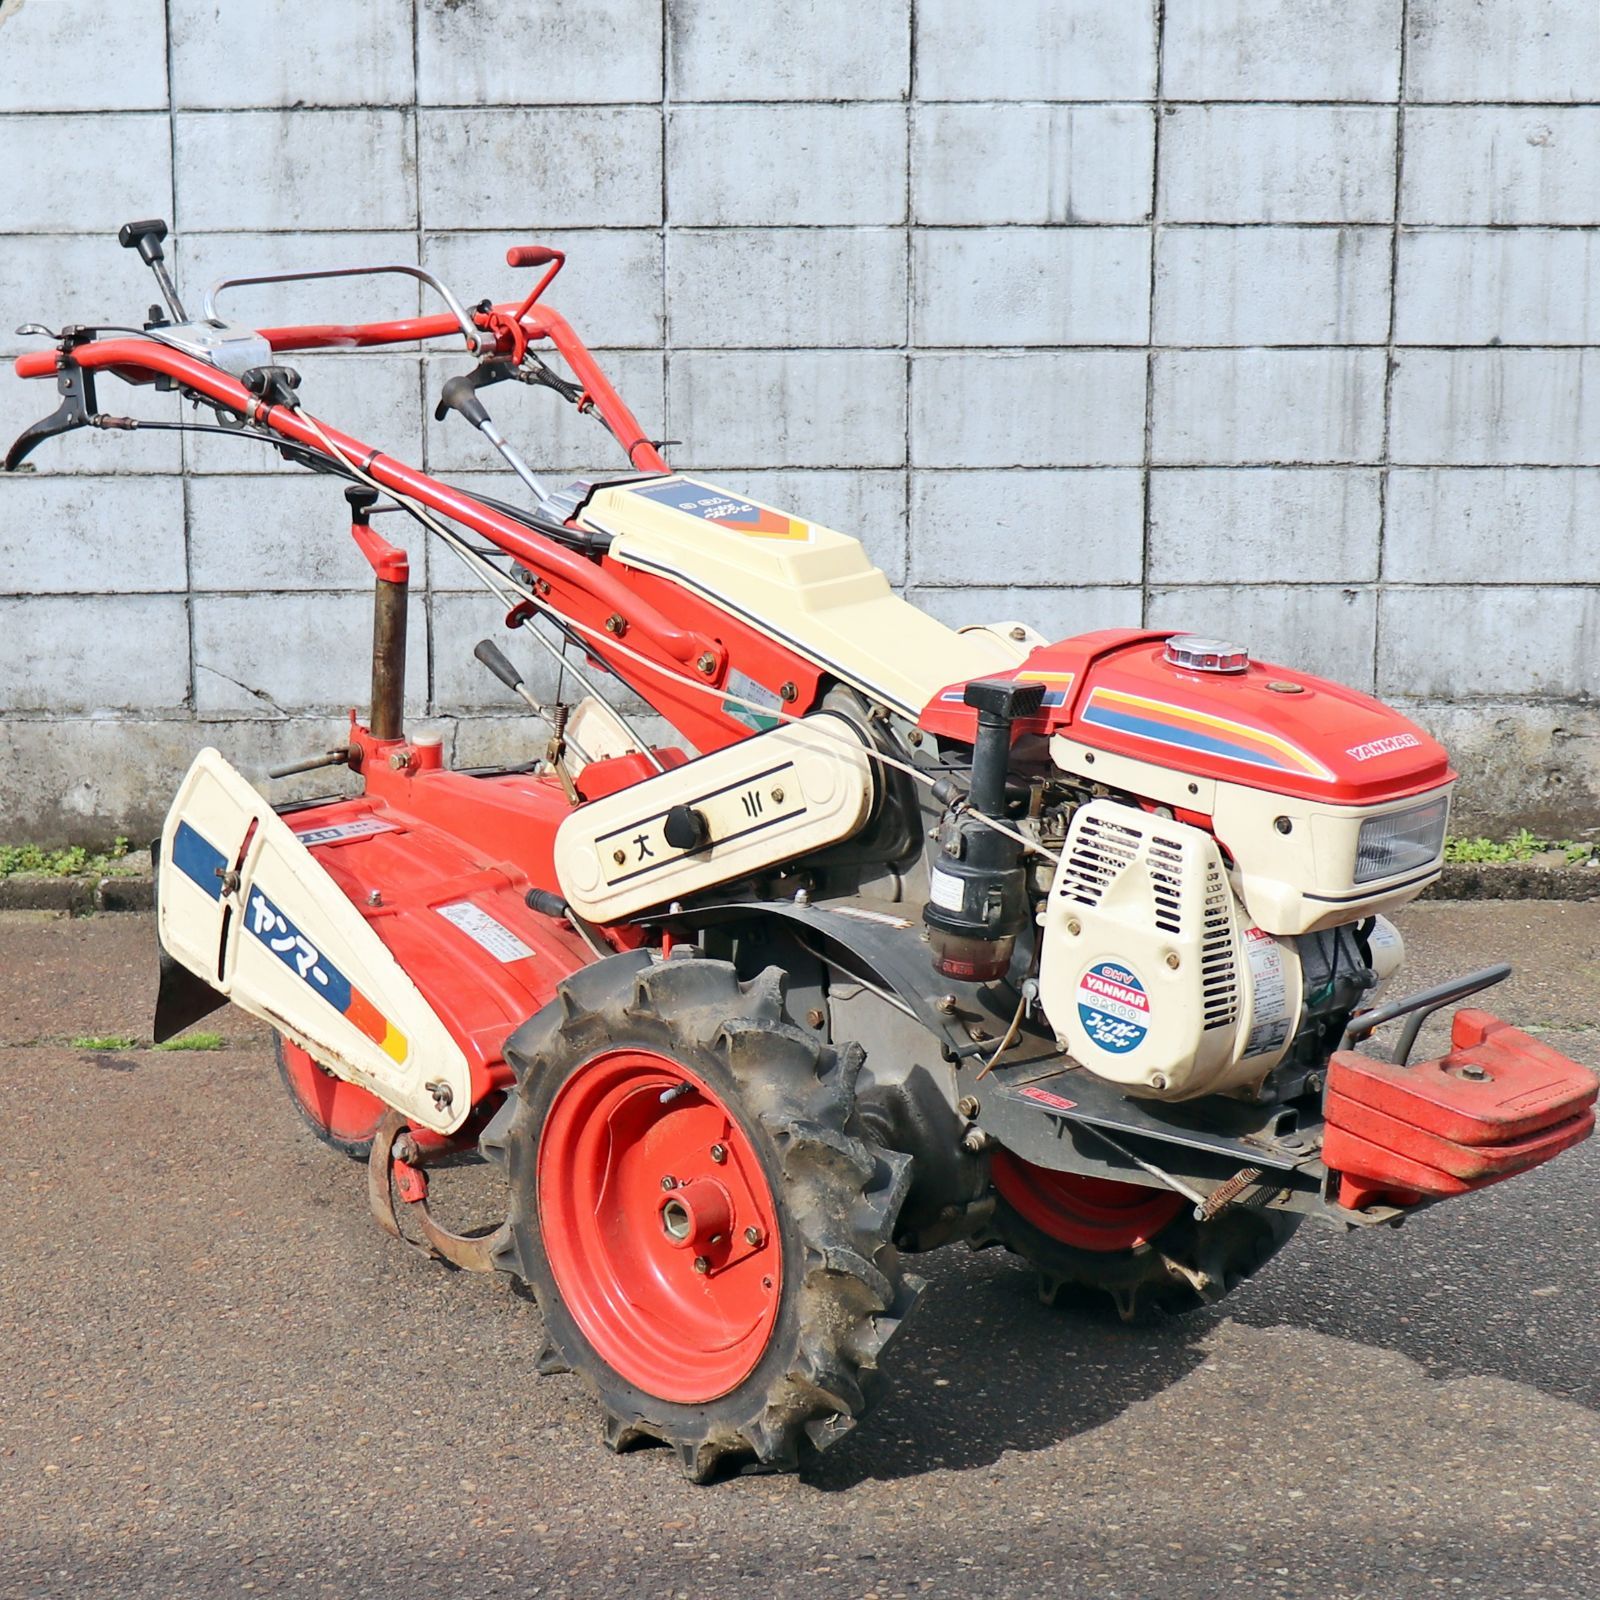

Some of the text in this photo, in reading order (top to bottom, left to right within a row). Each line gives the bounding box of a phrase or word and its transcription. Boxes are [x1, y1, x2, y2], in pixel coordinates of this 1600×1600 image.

[1345, 733, 1420, 762] YANMAR
[632, 833, 655, 862] 大
[251, 894, 329, 986] ヤンマー
[1102, 966, 1135, 985] OHV
[1086, 975, 1146, 1009] YANMAR
[1085, 1011, 1141, 1038] フィンガー
[1092, 1028, 1131, 1048] スタート
